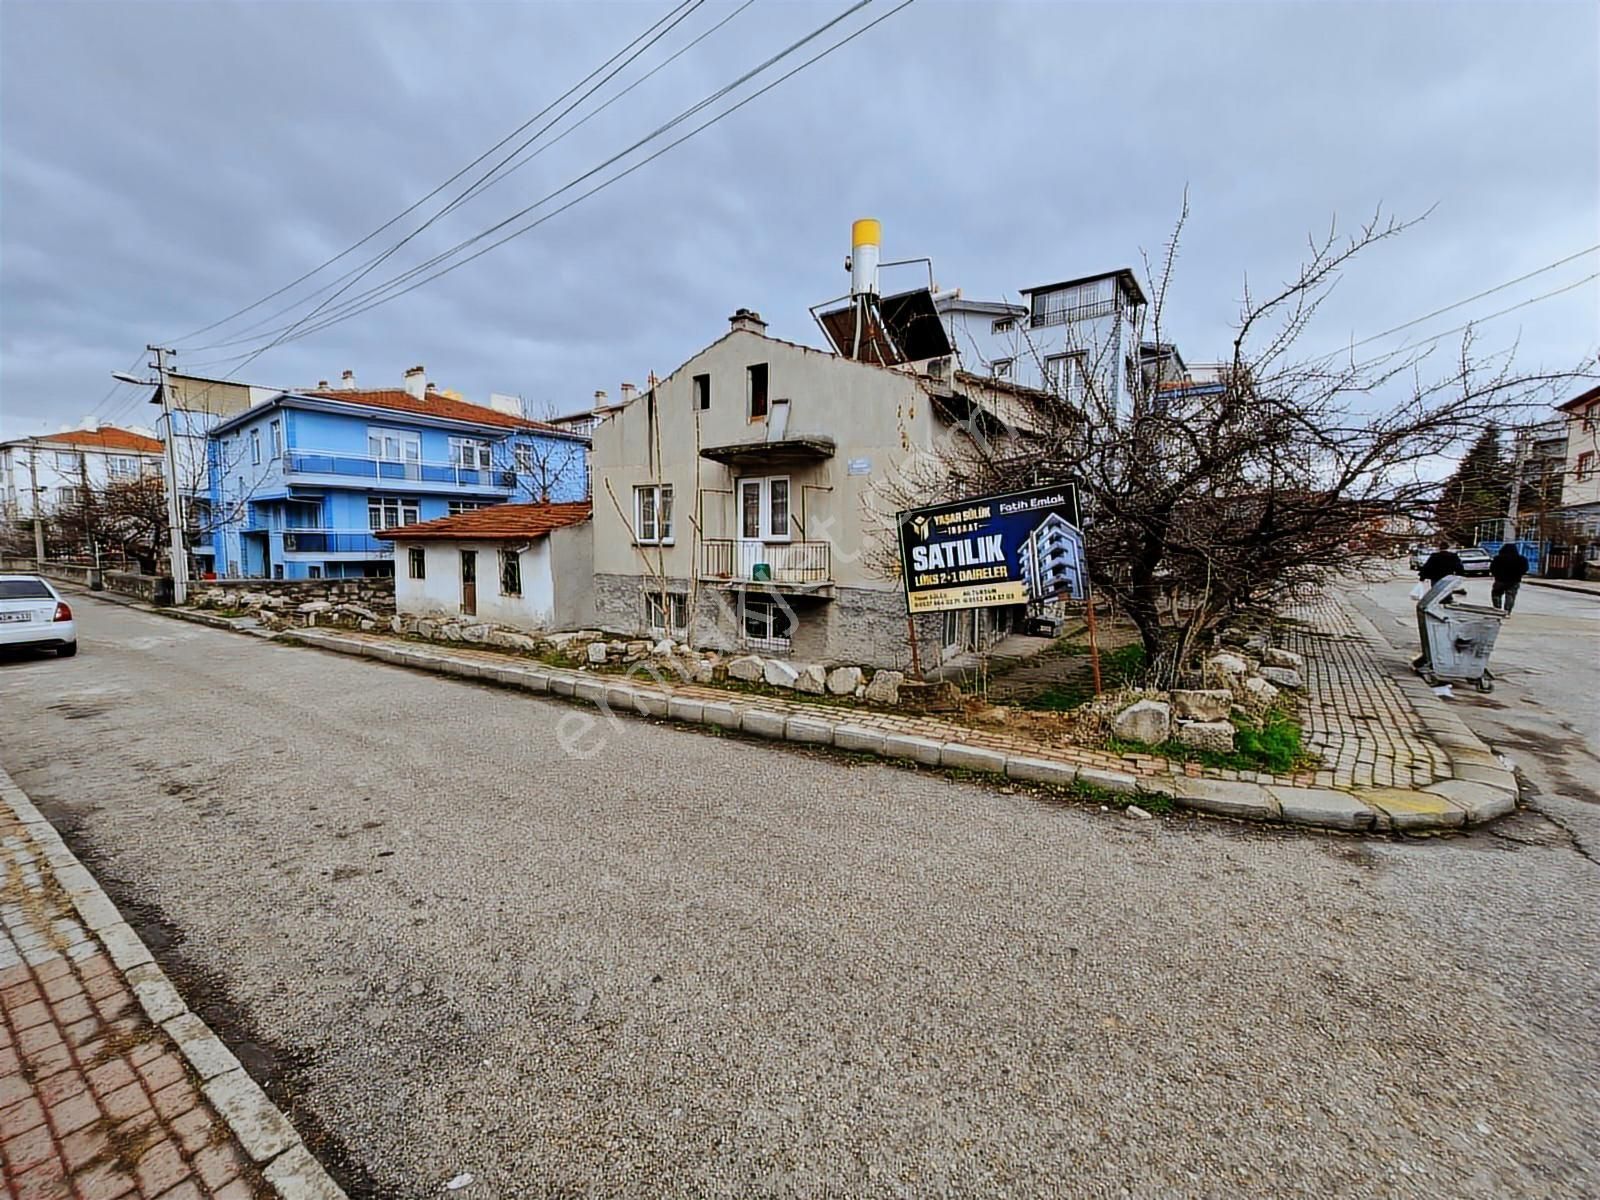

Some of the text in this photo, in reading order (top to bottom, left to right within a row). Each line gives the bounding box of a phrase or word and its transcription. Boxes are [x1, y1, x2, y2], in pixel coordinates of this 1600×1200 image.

[1000, 494, 1065, 512] Fatih Emlak
[912, 534, 1005, 571] SATILIK
